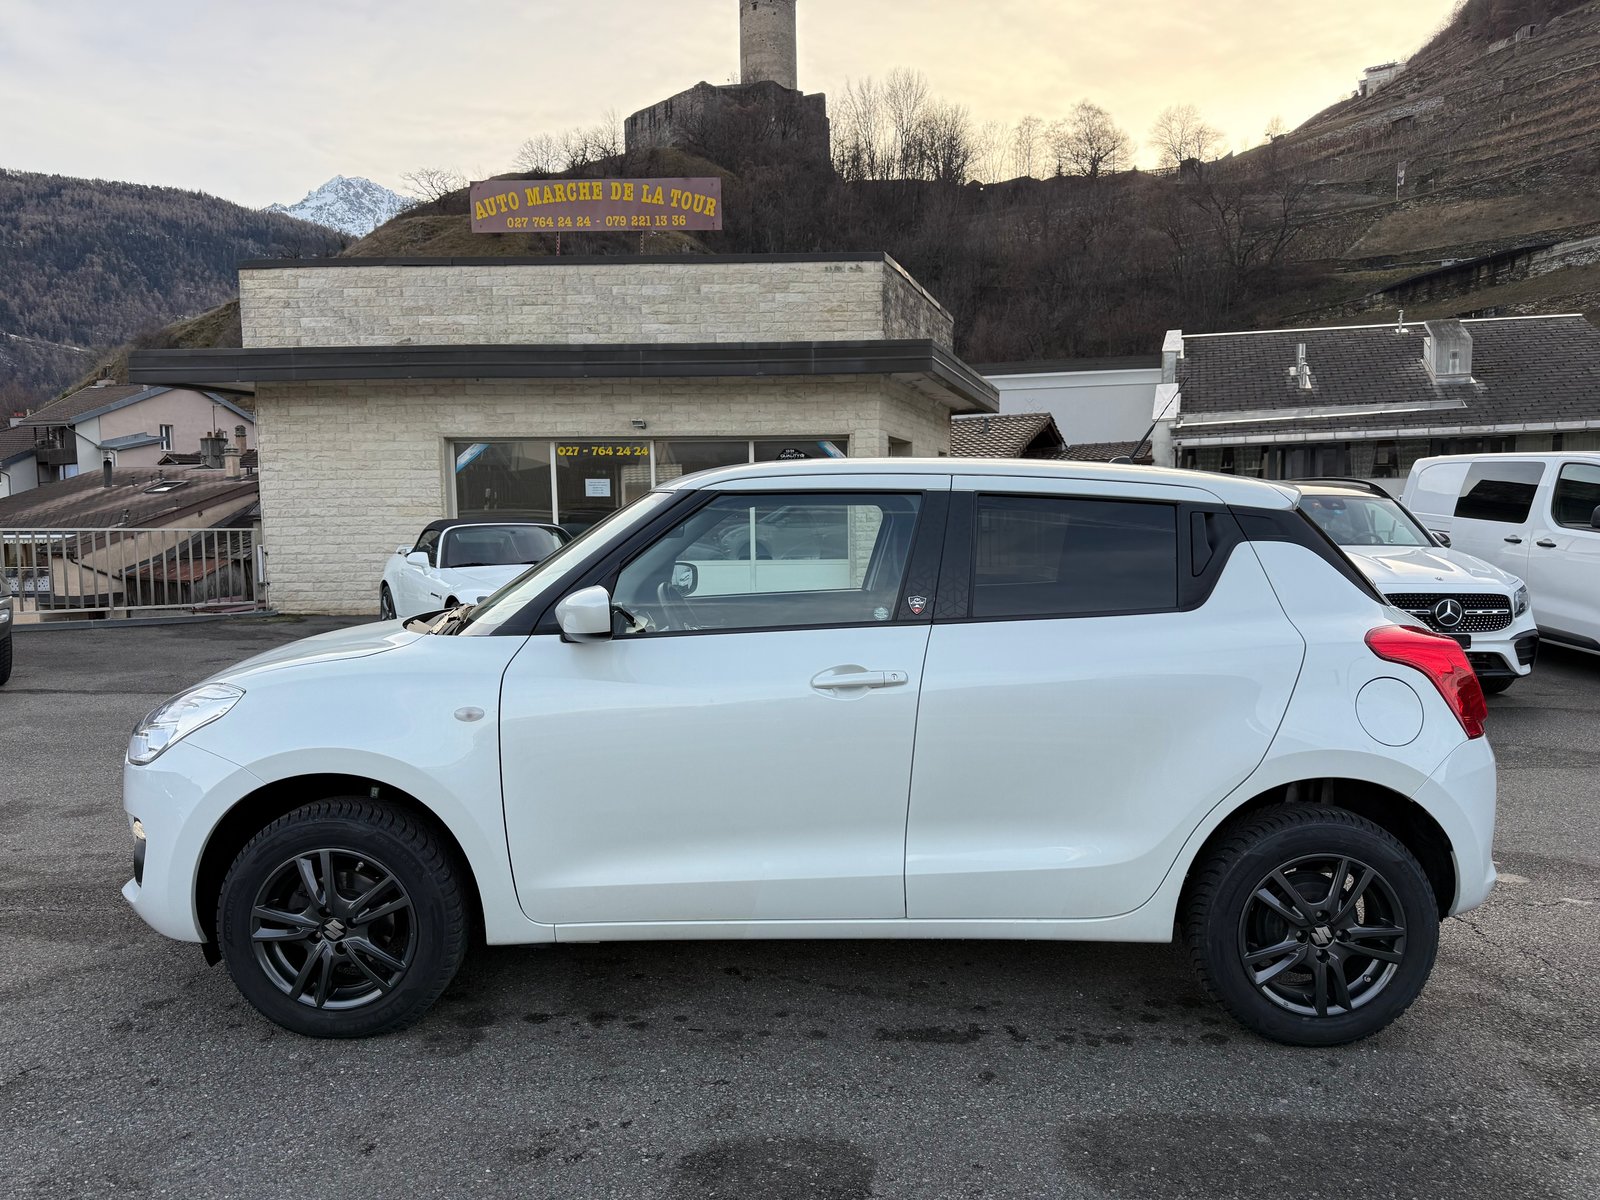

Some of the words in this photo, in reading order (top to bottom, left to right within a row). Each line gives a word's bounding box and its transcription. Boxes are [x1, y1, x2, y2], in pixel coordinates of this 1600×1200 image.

[475, 192, 520, 220] AUTO
[525, 181, 603, 207] MARCHE
[610, 182, 634, 201] DE
[641, 184, 664, 205] LA
[670, 188, 717, 217] TOUR
[506, 216, 529, 228] 027
[532, 216, 554, 228] 764
[557, 216, 573, 228] 24
[576, 215, 592, 227] 24
[605, 215, 627, 227] 079
[631, 215, 652, 227] 221
[655, 215, 668, 226] 13
[672, 214, 687, 226] 36
[557, 446, 580, 456] 027
[591, 446, 614, 456] 764
[616, 446, 632, 456] 24
[633, 446, 649, 456] 24
